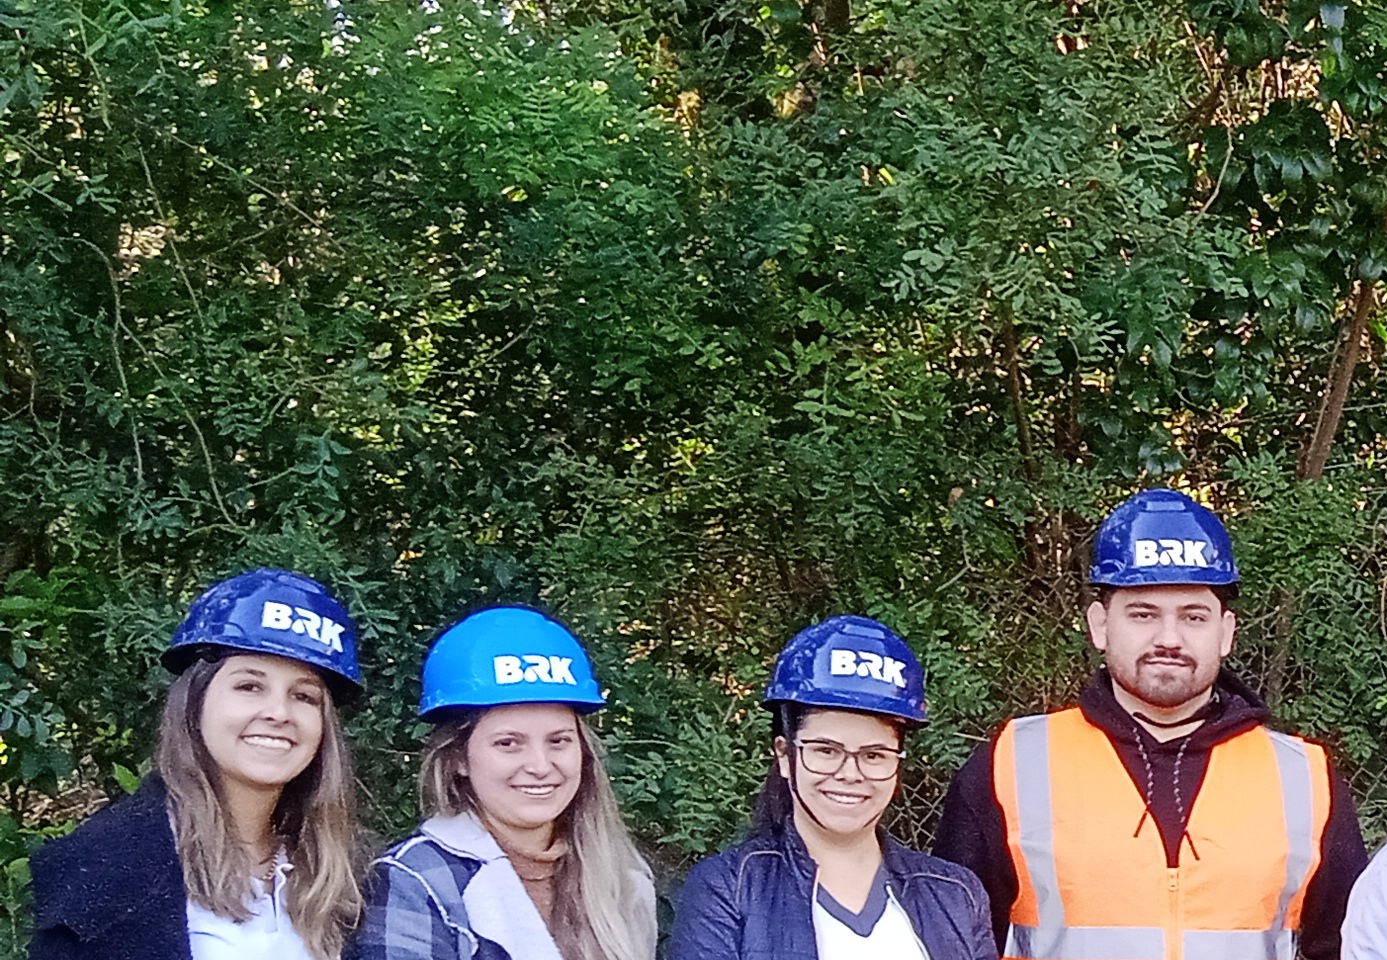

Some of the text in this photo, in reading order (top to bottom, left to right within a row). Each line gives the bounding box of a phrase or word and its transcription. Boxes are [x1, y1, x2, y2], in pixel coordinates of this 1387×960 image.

[1134, 539, 1209, 568] BRK
[261, 601, 346, 653] BRK
[493, 655, 578, 685] BRK
[830, 649, 908, 688] BRK
